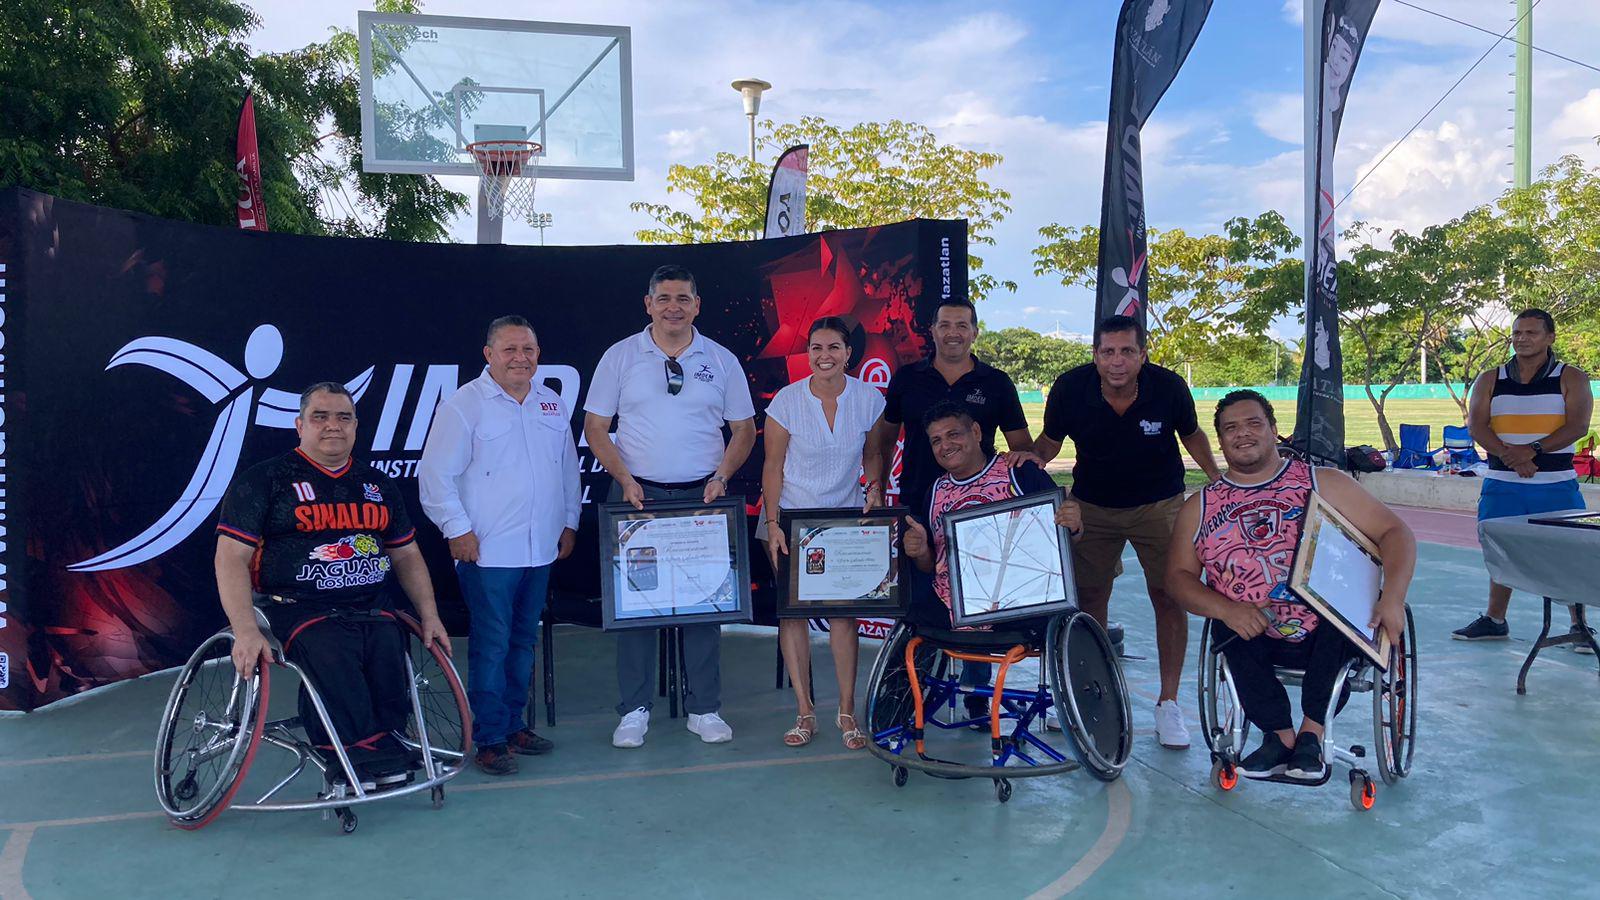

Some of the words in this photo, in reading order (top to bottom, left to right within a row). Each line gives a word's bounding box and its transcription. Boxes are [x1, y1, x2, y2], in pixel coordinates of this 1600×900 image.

[415, 29, 438, 39] ech
[292, 482, 316, 502] 10
[316, 579, 344, 589] LOS
[858, 622, 892, 638] AZAT
